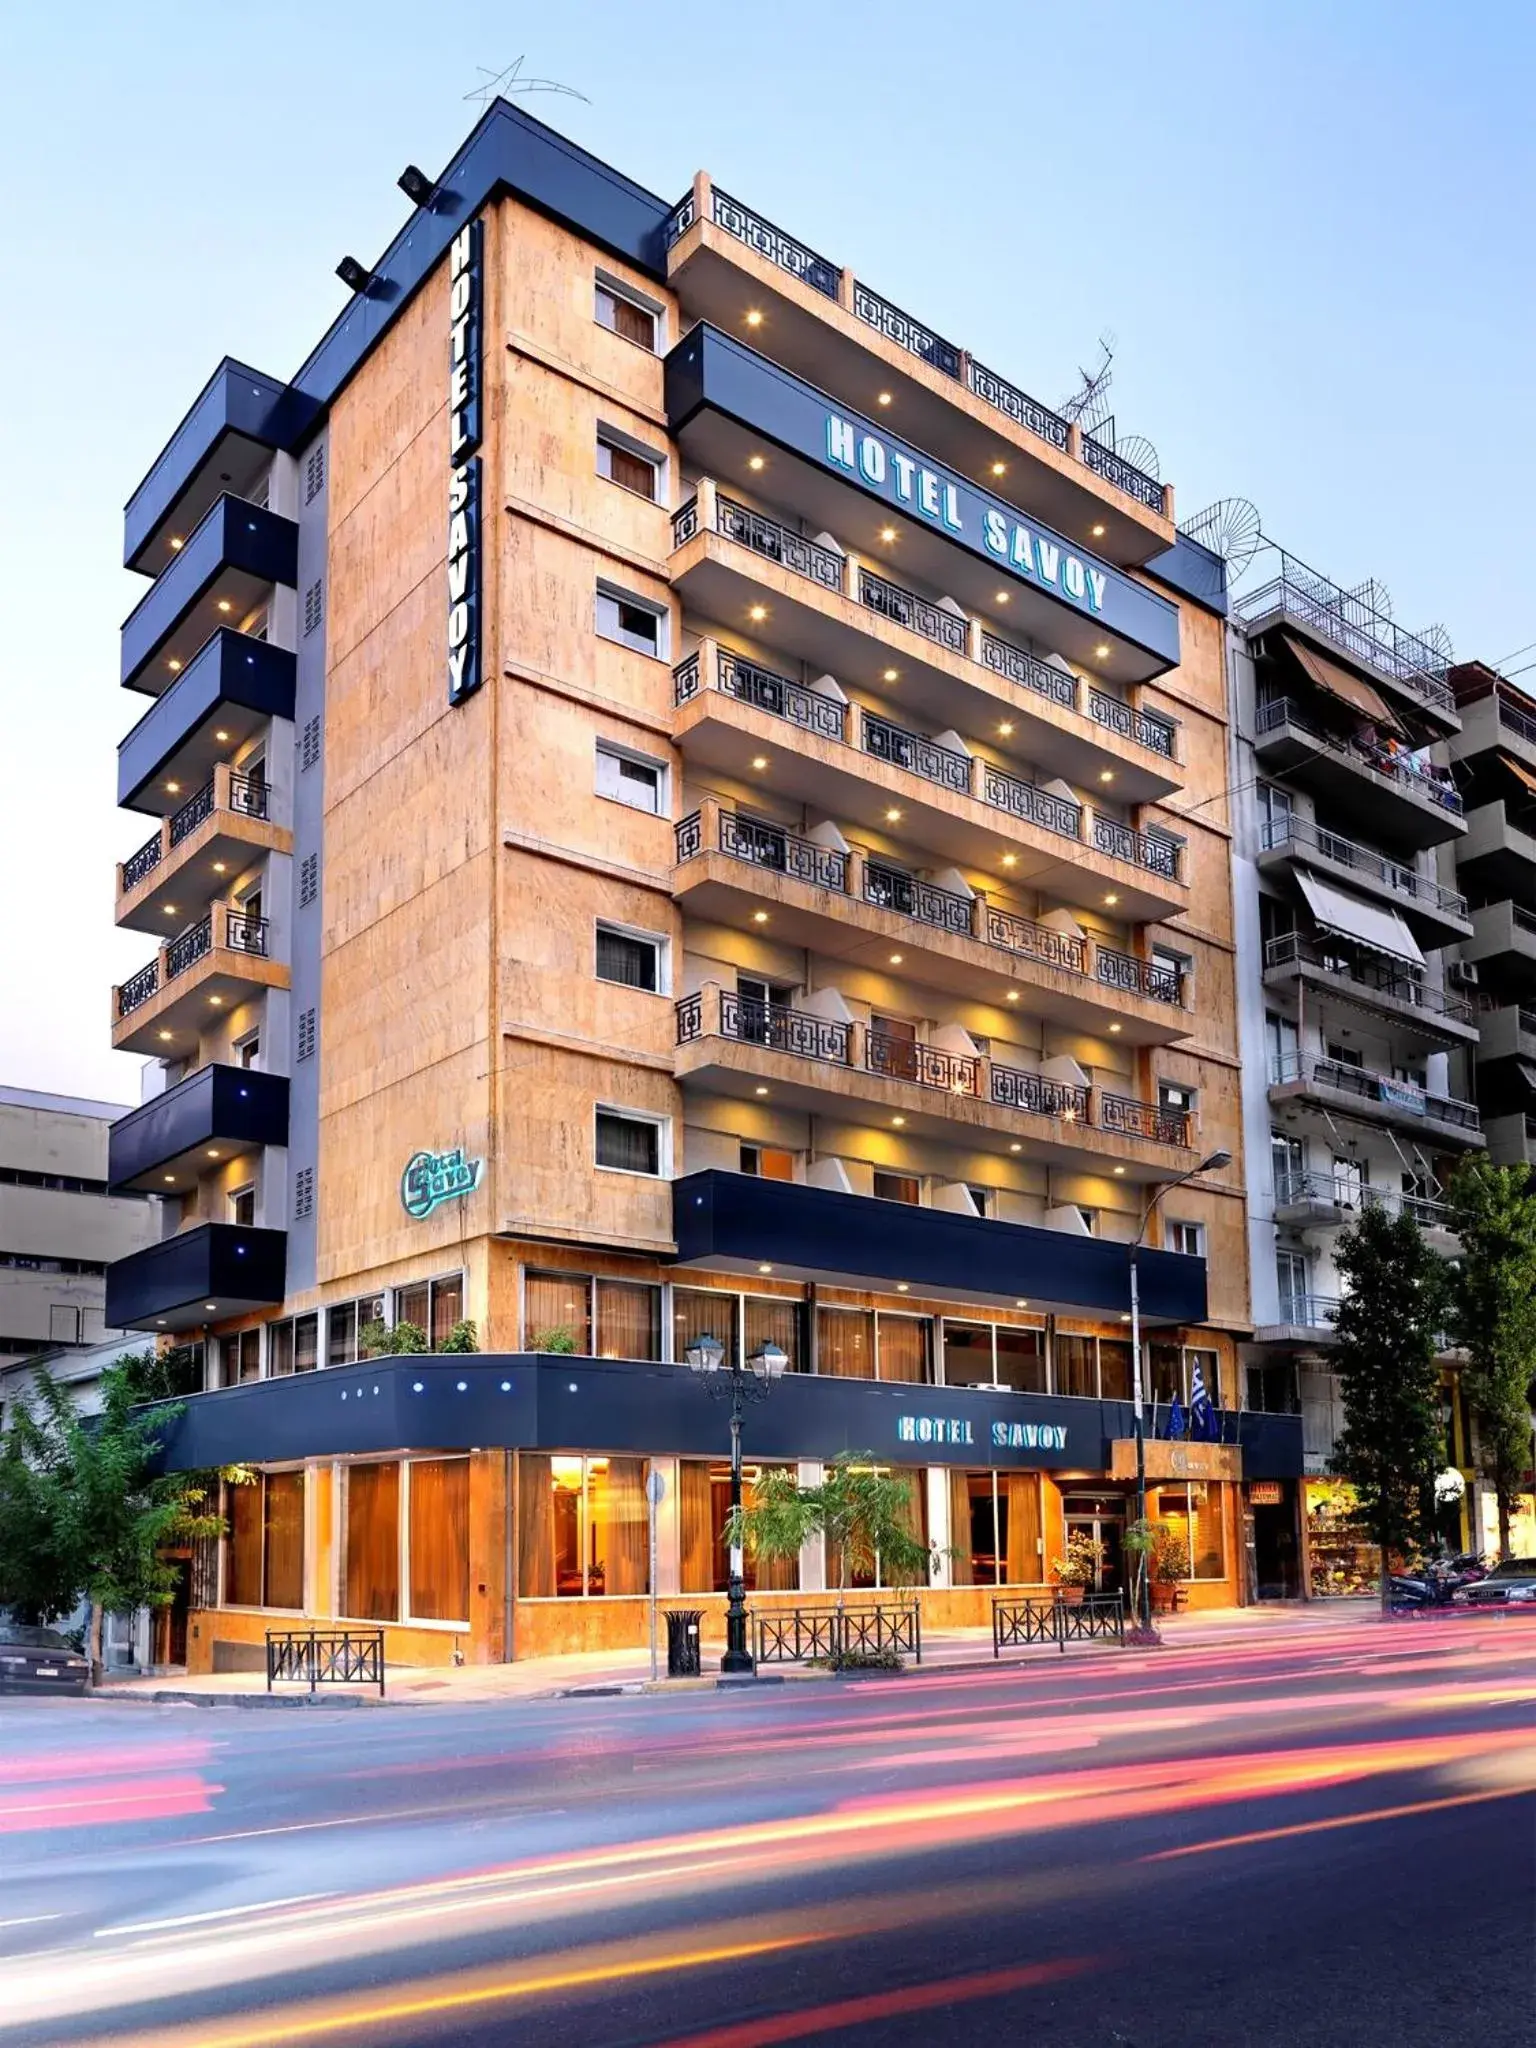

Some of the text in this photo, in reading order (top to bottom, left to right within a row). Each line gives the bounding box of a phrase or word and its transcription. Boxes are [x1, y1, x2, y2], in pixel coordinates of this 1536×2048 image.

[448, 223, 470, 693] HOTEL SAVOY
[826, 414, 1107, 612] HOTEL SAVOY
[898, 1415, 1068, 1450] HOTEL SAVOY
